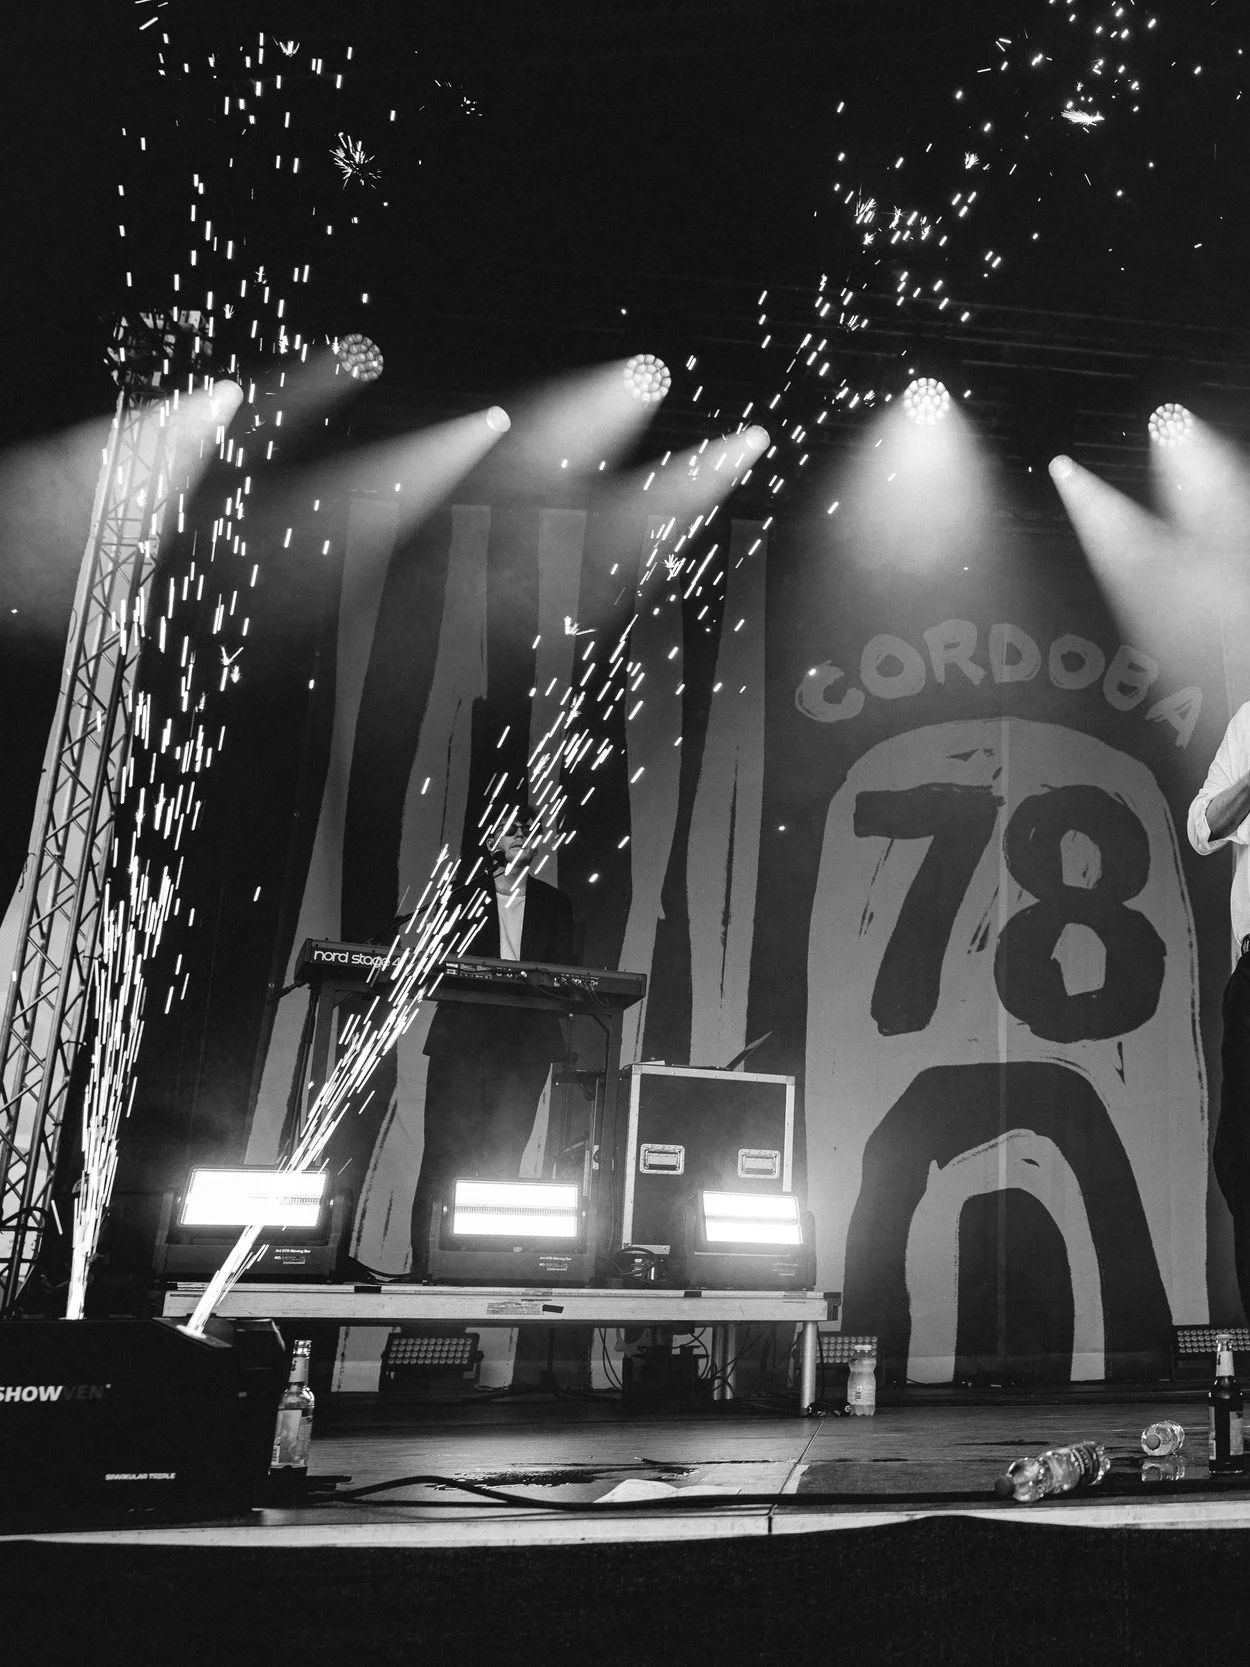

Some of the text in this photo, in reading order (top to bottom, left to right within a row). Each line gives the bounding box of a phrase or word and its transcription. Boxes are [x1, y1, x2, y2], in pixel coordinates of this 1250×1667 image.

[795, 619, 1203, 749] CORDOBA
[314, 950, 349, 963] nord
[351, 953, 391, 968] stage
[853, 782, 1167, 1044] 78
